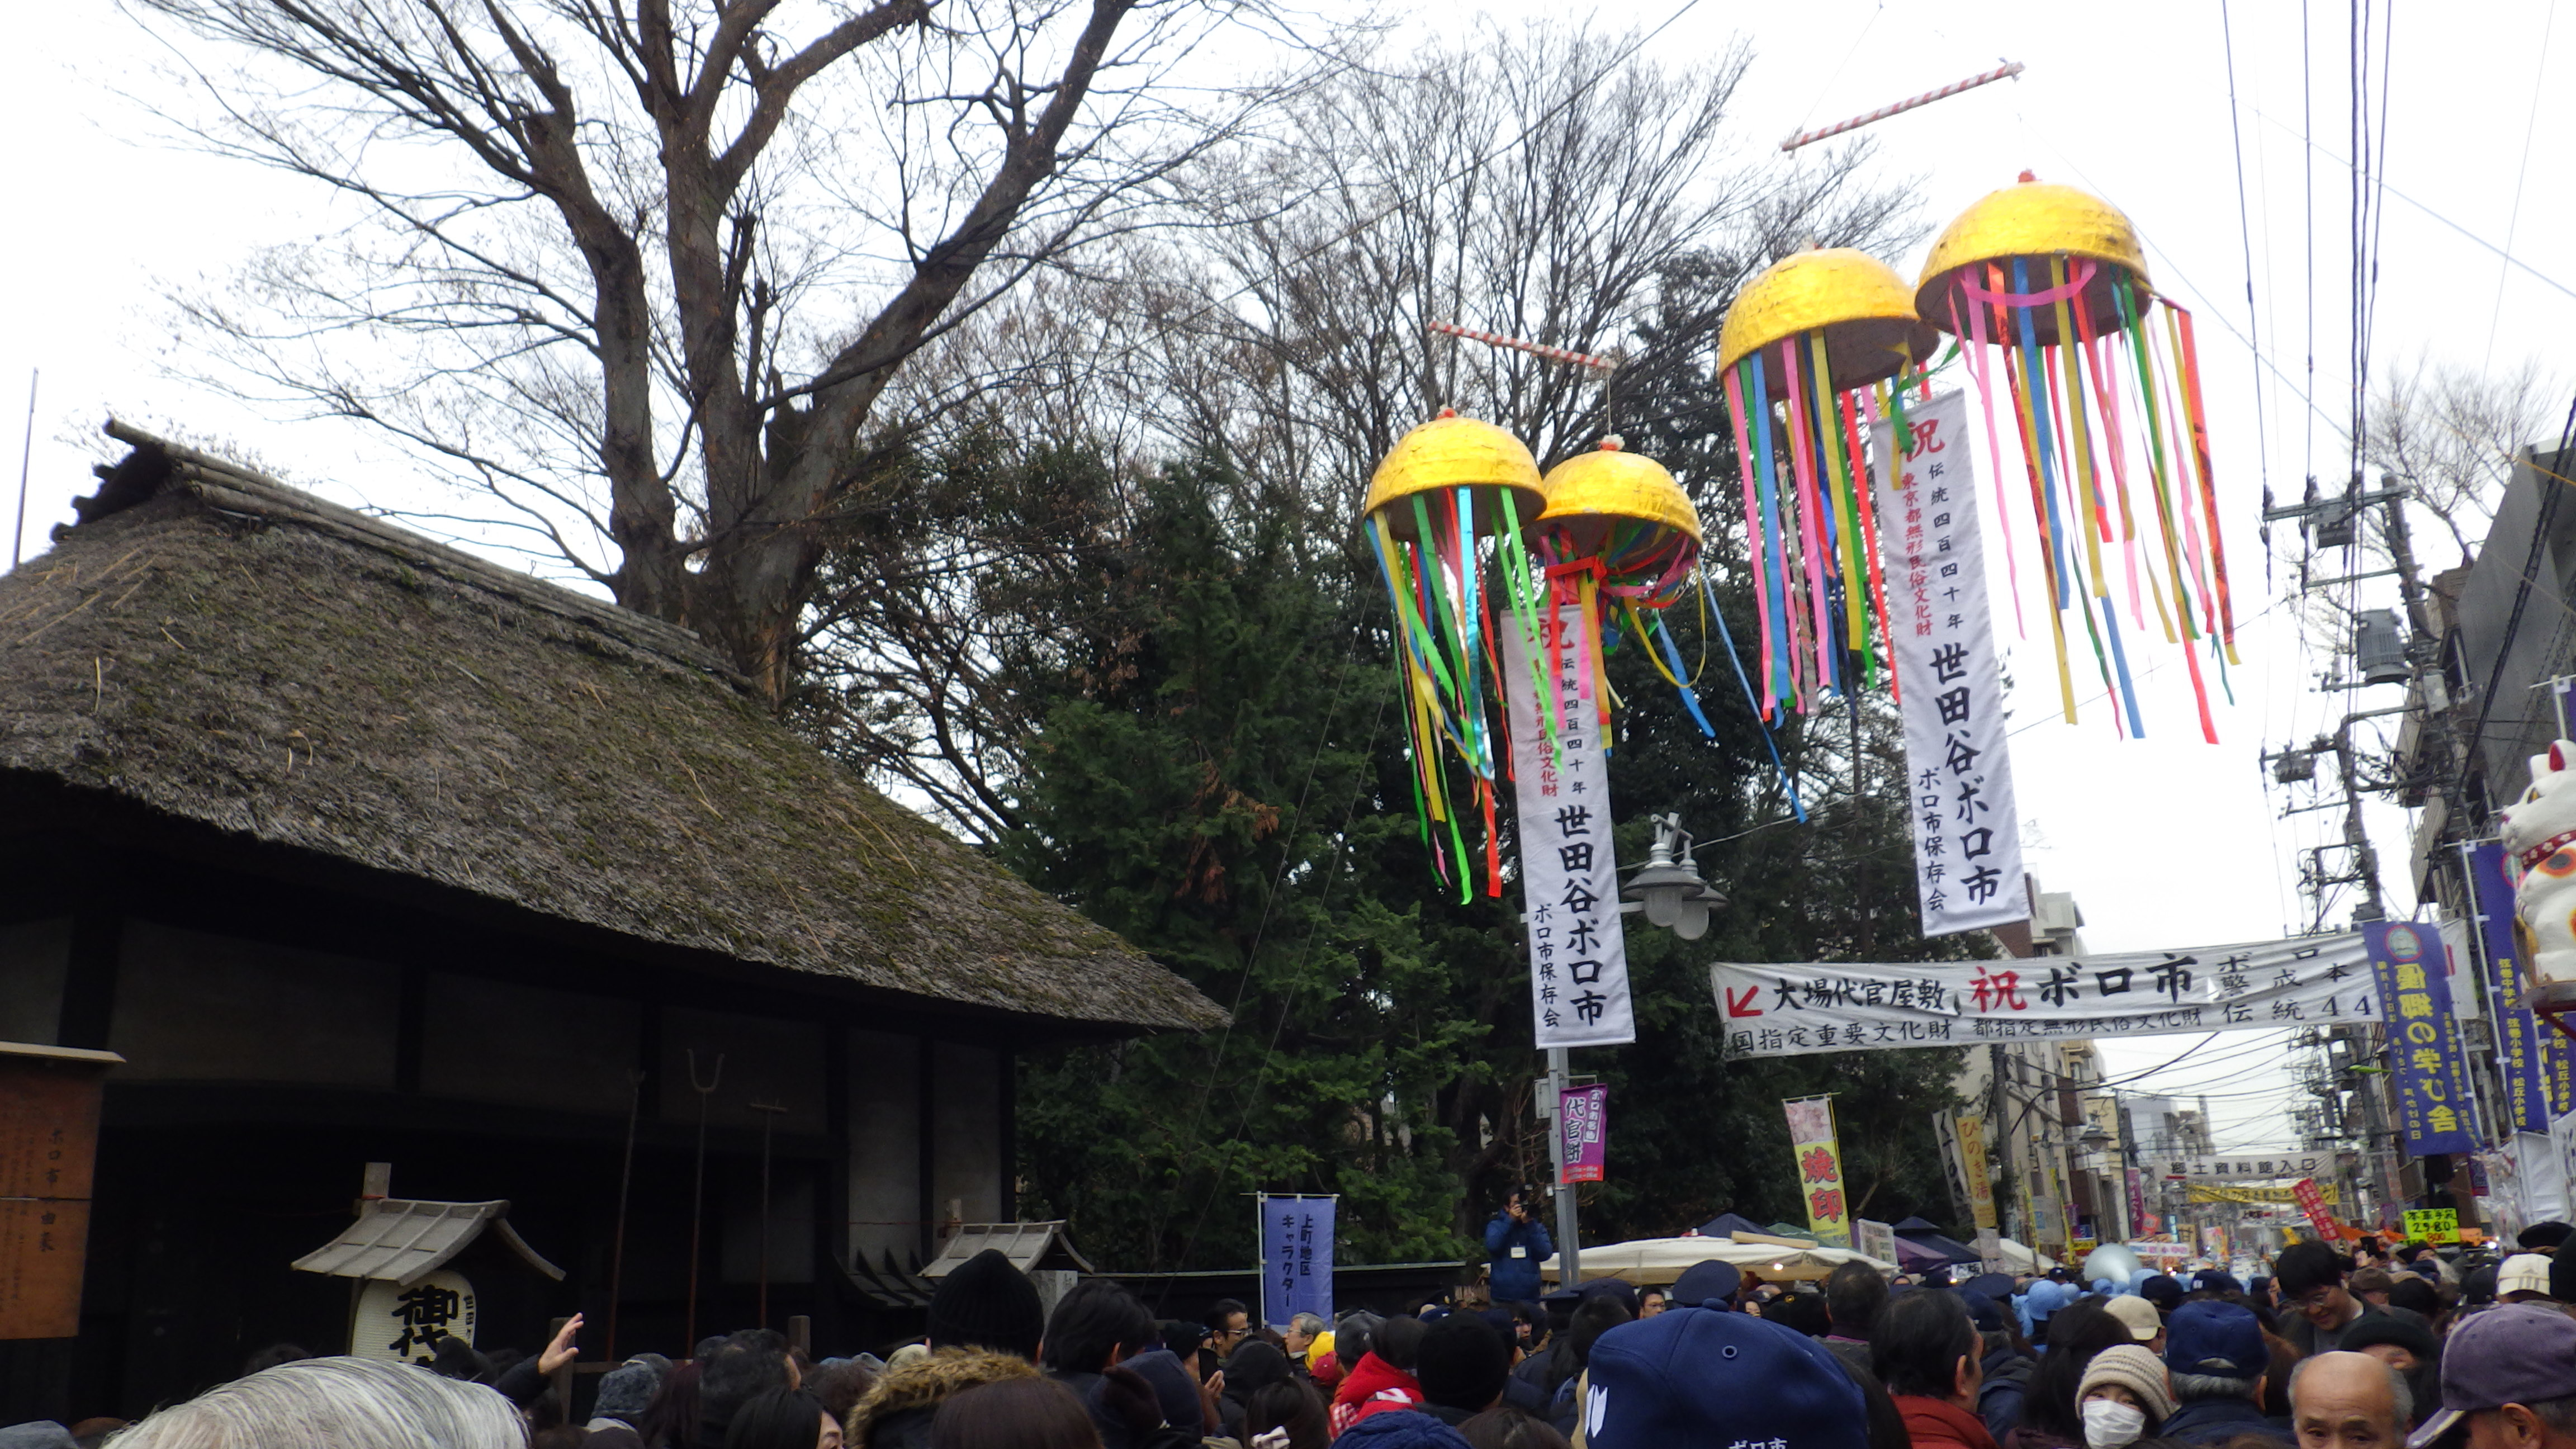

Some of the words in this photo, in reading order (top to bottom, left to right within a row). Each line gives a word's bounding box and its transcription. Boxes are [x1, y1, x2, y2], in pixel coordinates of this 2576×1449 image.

[1900, 418, 1945, 462] 祝
[1901, 472, 1934, 637] 東京都無形民俗文化財
[1929, 462, 1964, 630] 伝統四百四十年
[1562, 659, 1587, 794] 伝統四百四十年
[1929, 642, 2002, 906] 世田谷ボロ市
[1919, 767, 1947, 911] ボロ市保存会
[1534, 903, 1561, 1027] ボロ市保存会
[1555, 804, 1607, 1026] 世田谷ボロ市
[1734, 1019, 1952, 1053] 国指定重要文化財
[1973, 1007, 2202, 1038] 都指定無形民俗文化財
[1773, 977, 1947, 1012] 大場代官屋敷
[1566, 1097, 1585, 1164] 代官餅
[1801, 1147, 1843, 1223] 焼印
[1282, 1214, 1295, 1307] キャラクター
[389, 1284, 460, 1365] 御代
